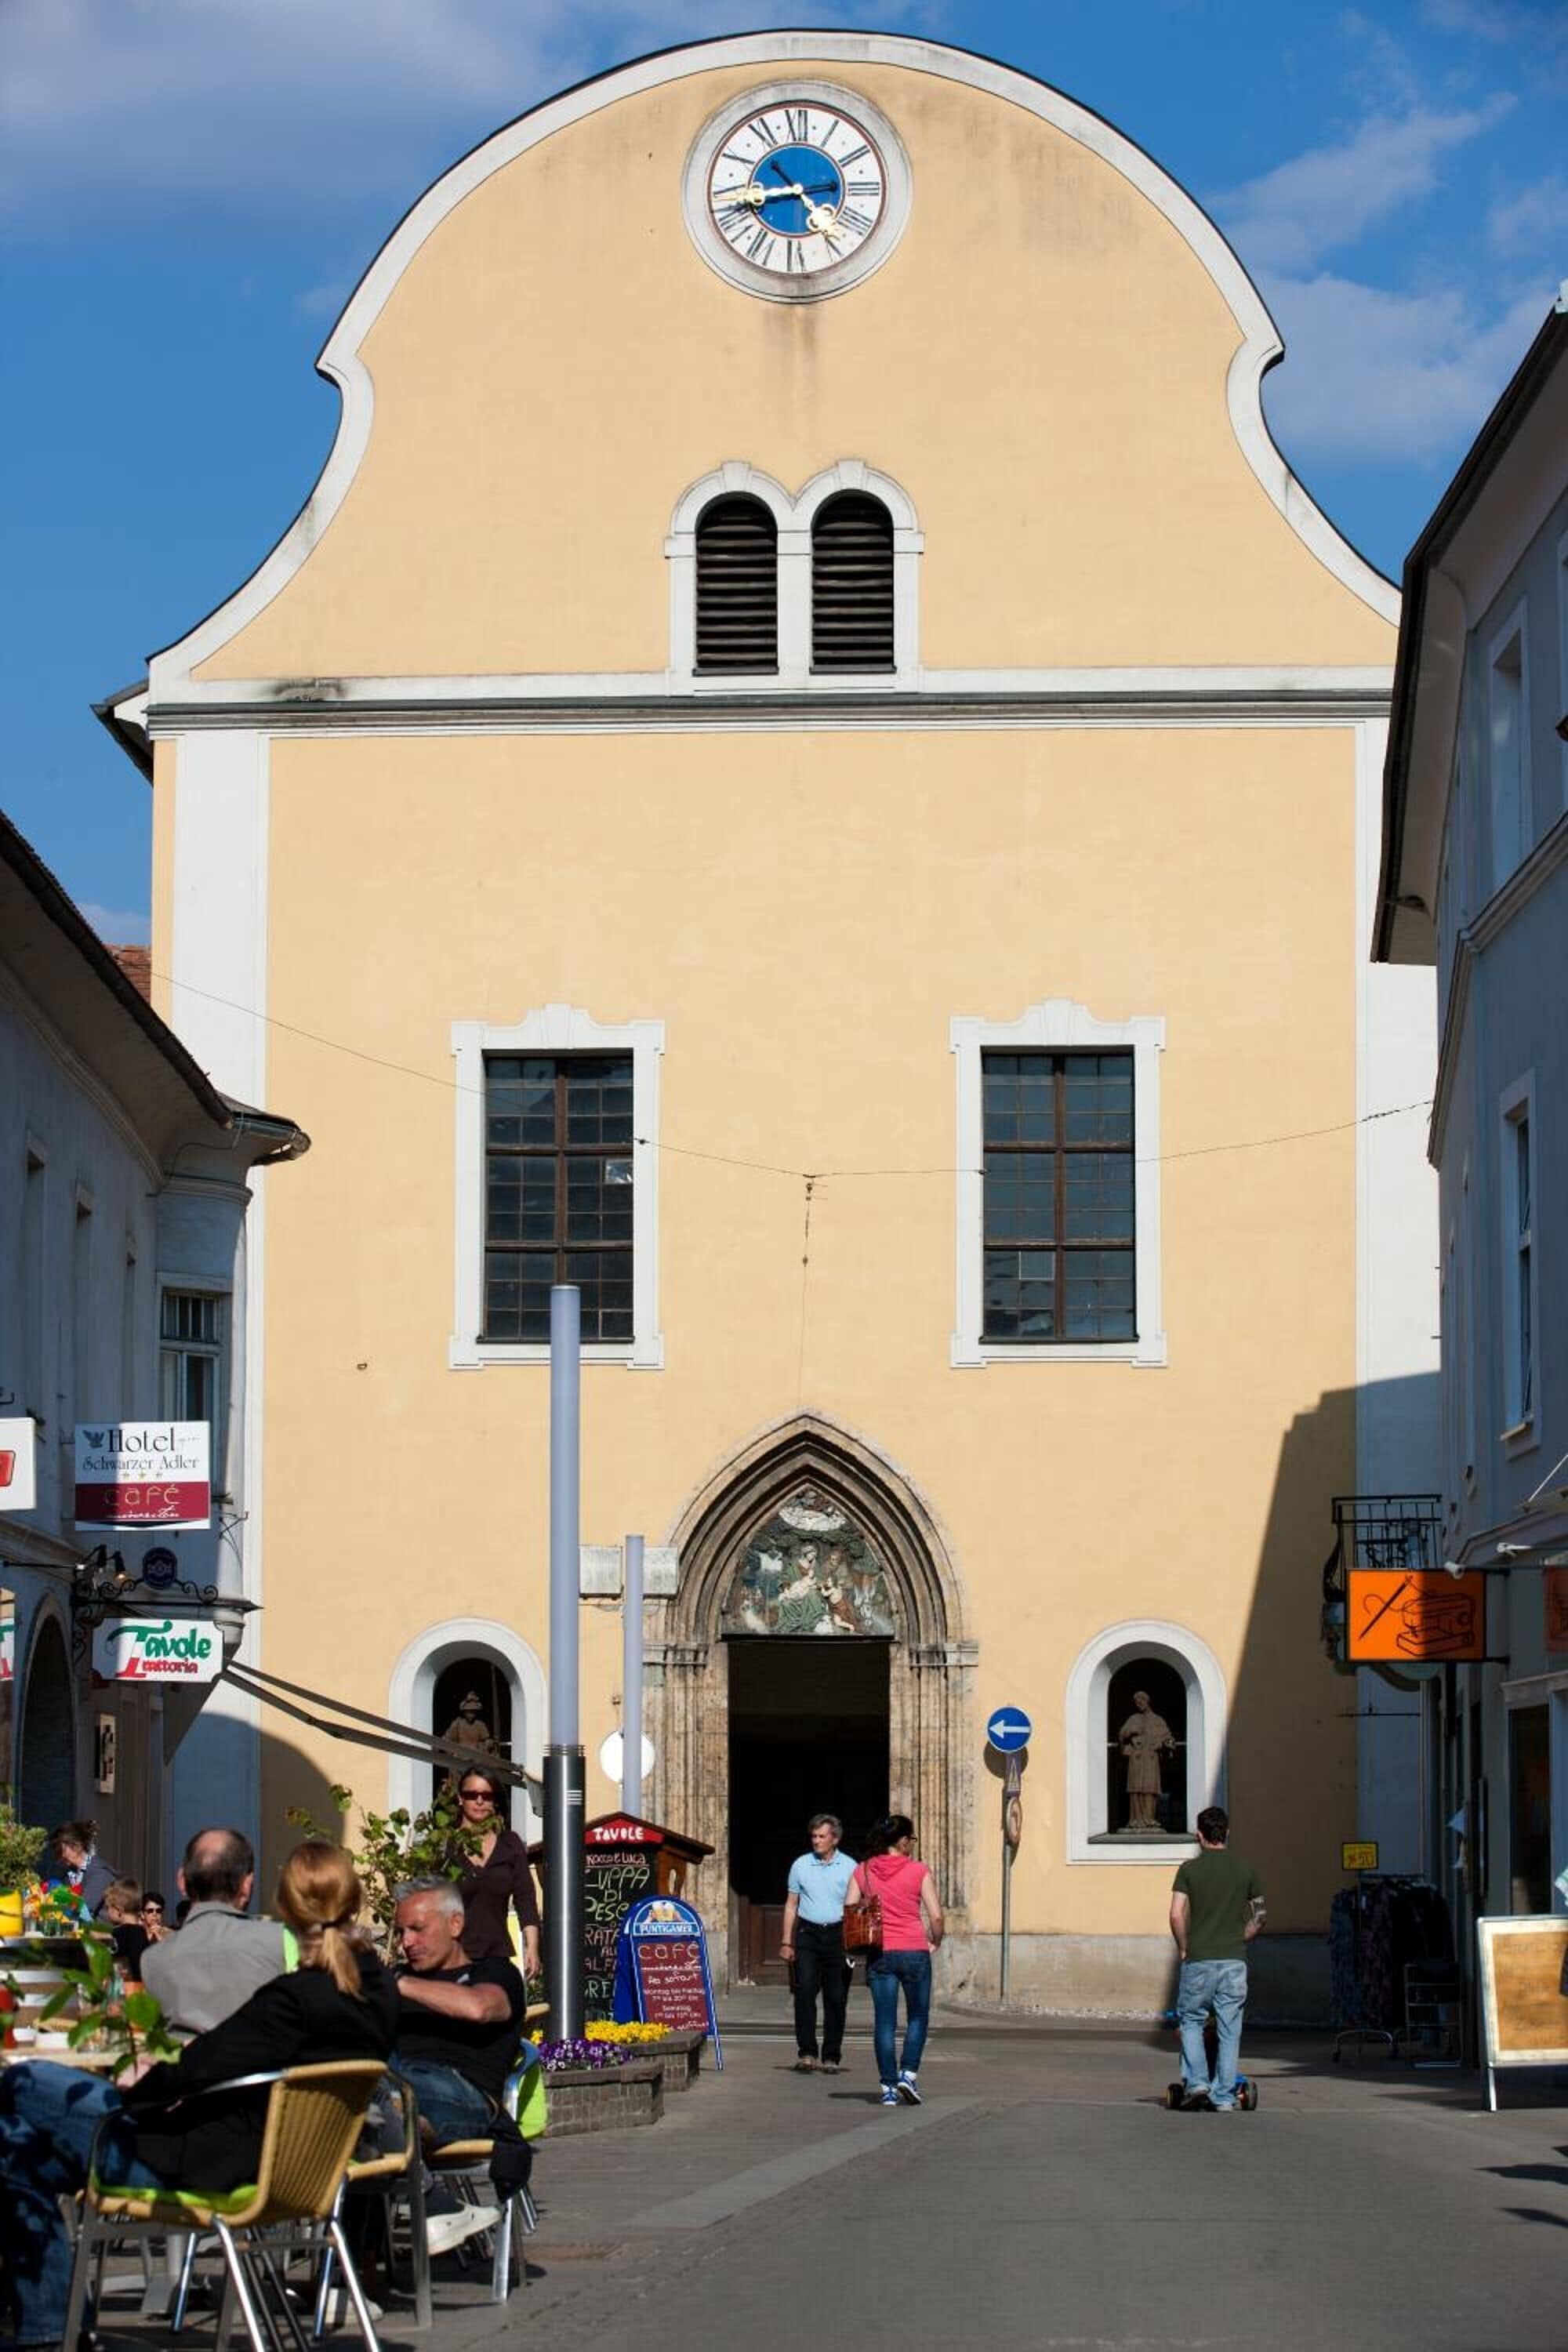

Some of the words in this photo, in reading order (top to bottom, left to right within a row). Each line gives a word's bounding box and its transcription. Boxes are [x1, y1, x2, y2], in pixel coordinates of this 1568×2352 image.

[784, 110, 808, 141] XII
[838, 144, 870, 167] II
[846, 181, 880, 196] III
[107, 1428, 176, 1453] Hotel
[82, 1455, 153, 1470] Schwarzer
[159, 1454, 200, 1469] Adler
[105, 1620, 212, 1659] Tavole
[604, 1889, 622, 1902] DI
